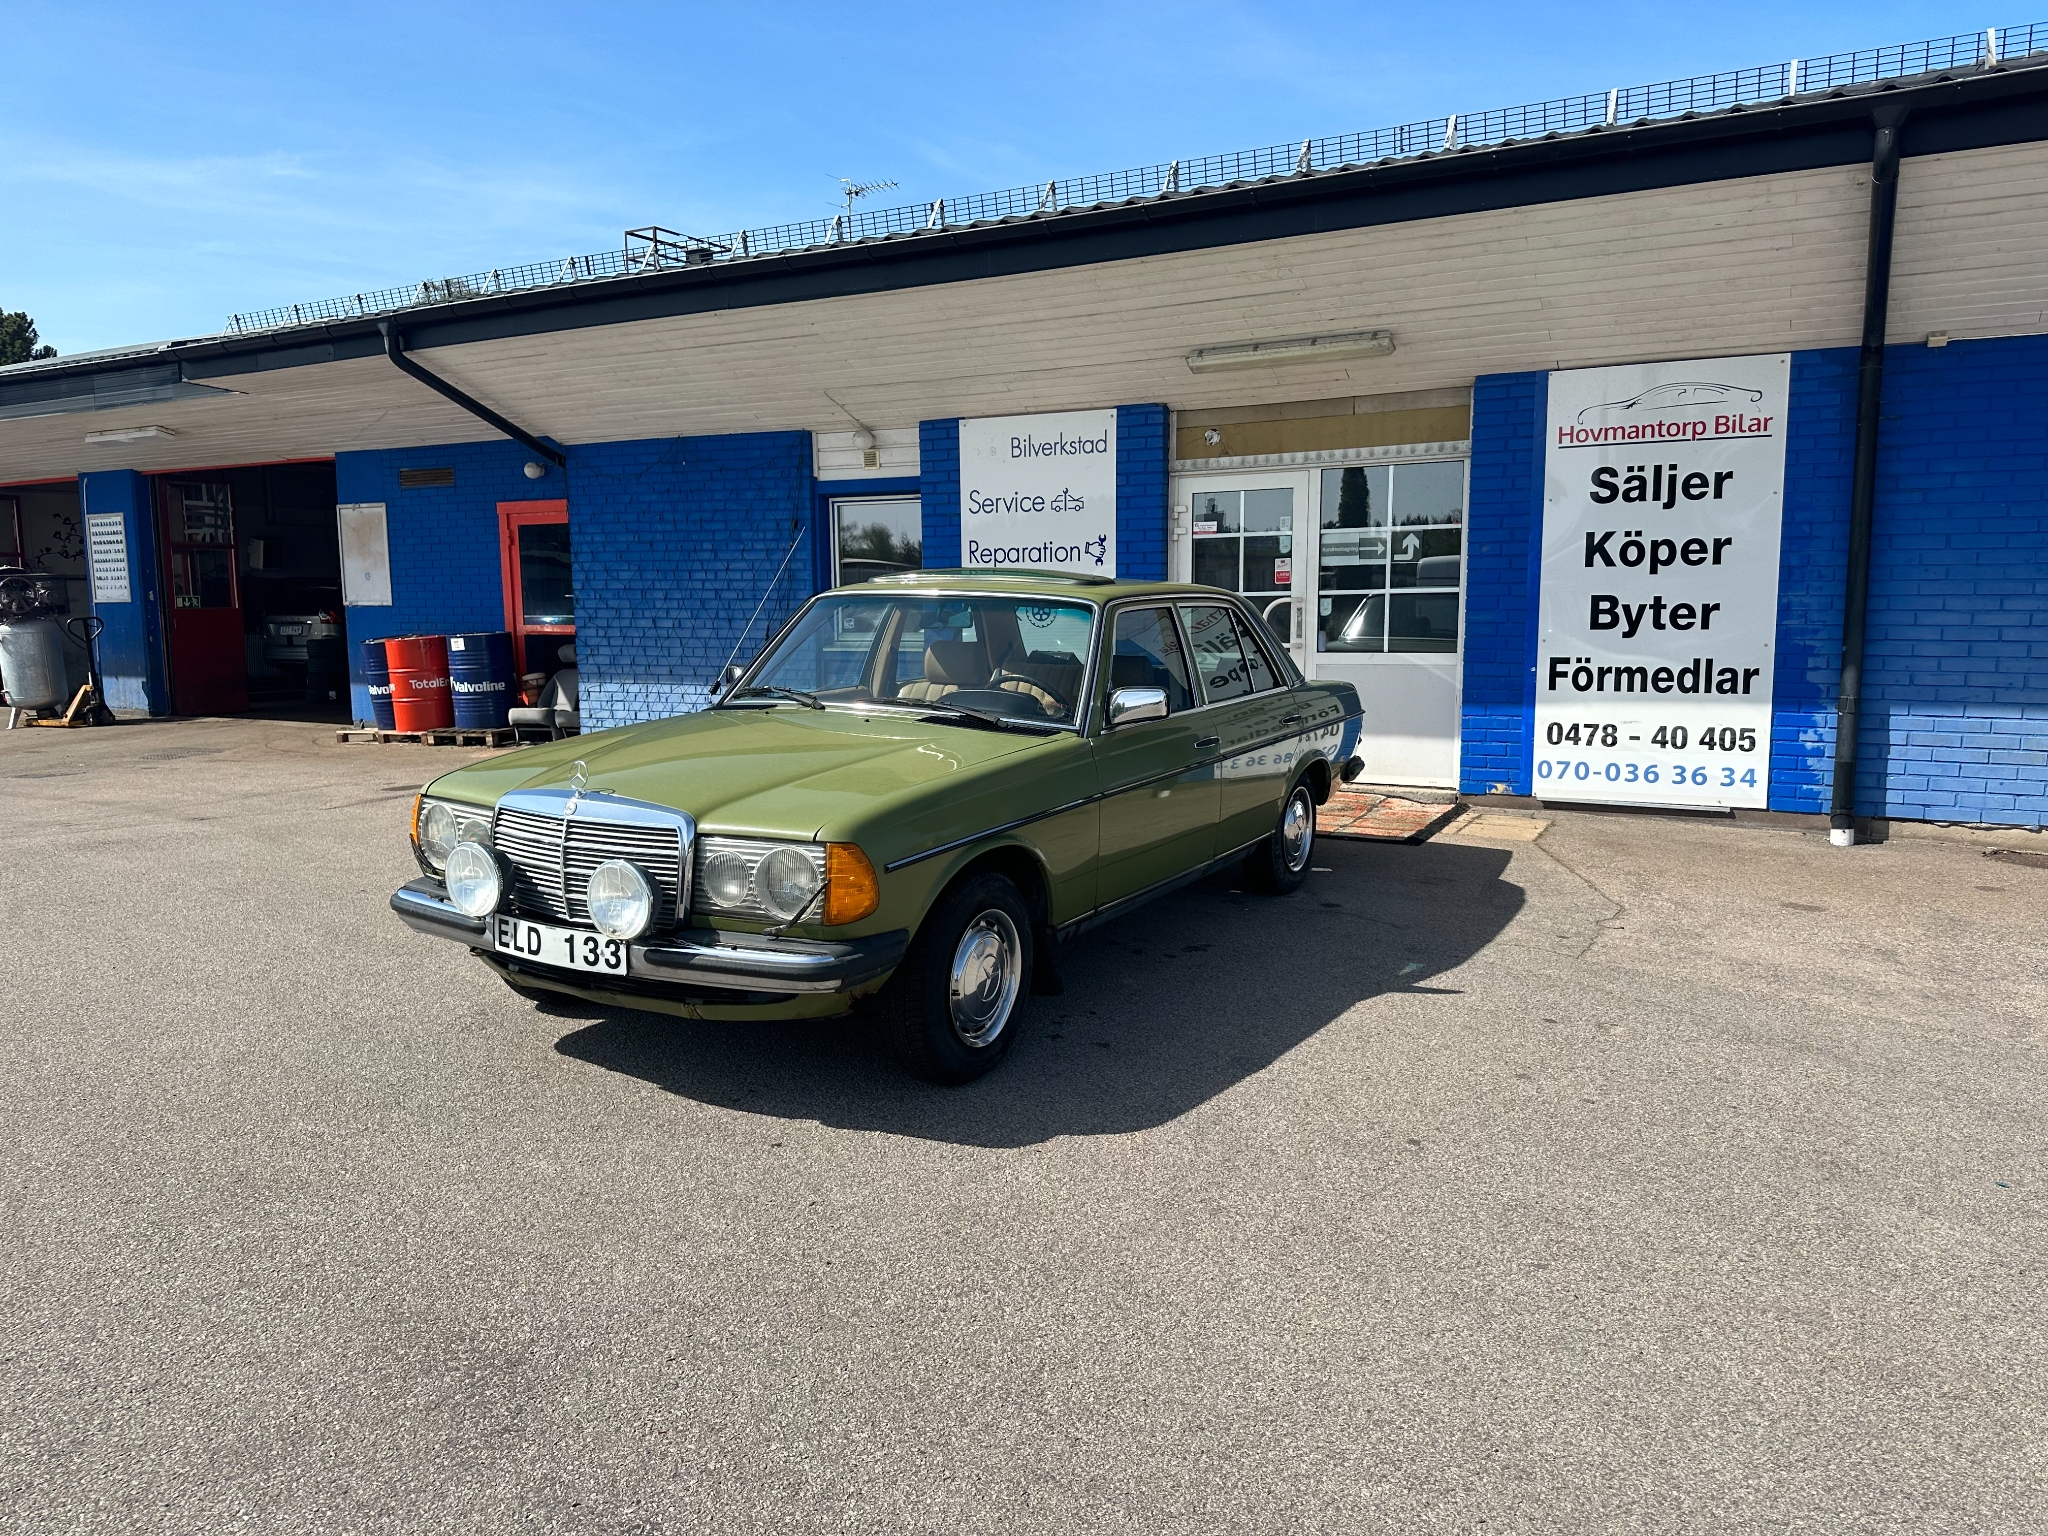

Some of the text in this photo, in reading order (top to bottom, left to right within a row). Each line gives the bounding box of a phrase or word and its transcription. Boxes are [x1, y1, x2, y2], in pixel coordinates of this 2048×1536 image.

[1011, 429, 1107, 458] Bilverkstad
[1558, 413, 1773, 444] Hovmantorp Bilar
[1589, 463, 1733, 510] Säljer
[969, 490, 1045, 514] Service
[969, 540, 1080, 567] Reparation
[1584, 530, 1732, 575] Köper
[1590, 594, 1720, 638] Byter
[453, 681, 505, 693] Valvoline
[1548, 657, 1760, 694] Förmedlar
[1547, 722, 1618, 747] 0478
[1651, 726, 1688, 749] 40
[1699, 727, 1756, 752] 405
[1537, 760, 1757, 788] 070-036 36 34
[498, 917, 621, 969] ELD 133
